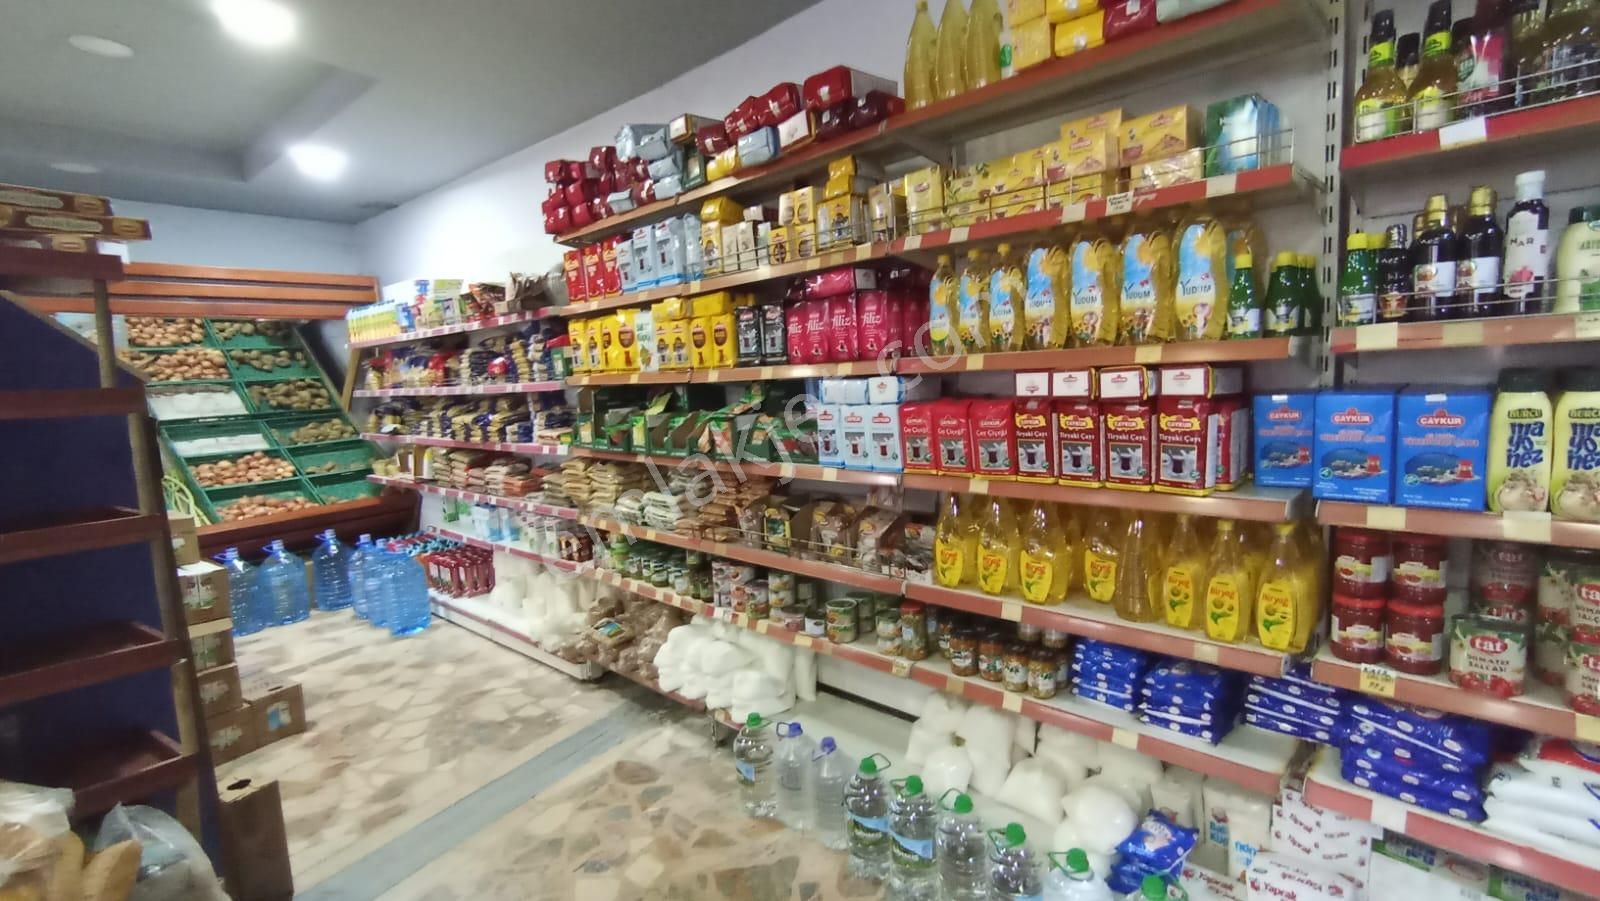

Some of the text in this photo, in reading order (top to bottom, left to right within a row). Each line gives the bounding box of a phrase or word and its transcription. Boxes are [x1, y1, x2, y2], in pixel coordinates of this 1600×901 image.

[805, 318, 824, 334] filiz
[832, 314, 852, 329] filiz
[862, 311, 881, 327] filiz
[1506, 449, 1543, 469] nez
[1581, 586, 1600, 602] ta
[1474, 638, 1502, 653] tat
[1264, 881, 1297, 900] Yaprak
